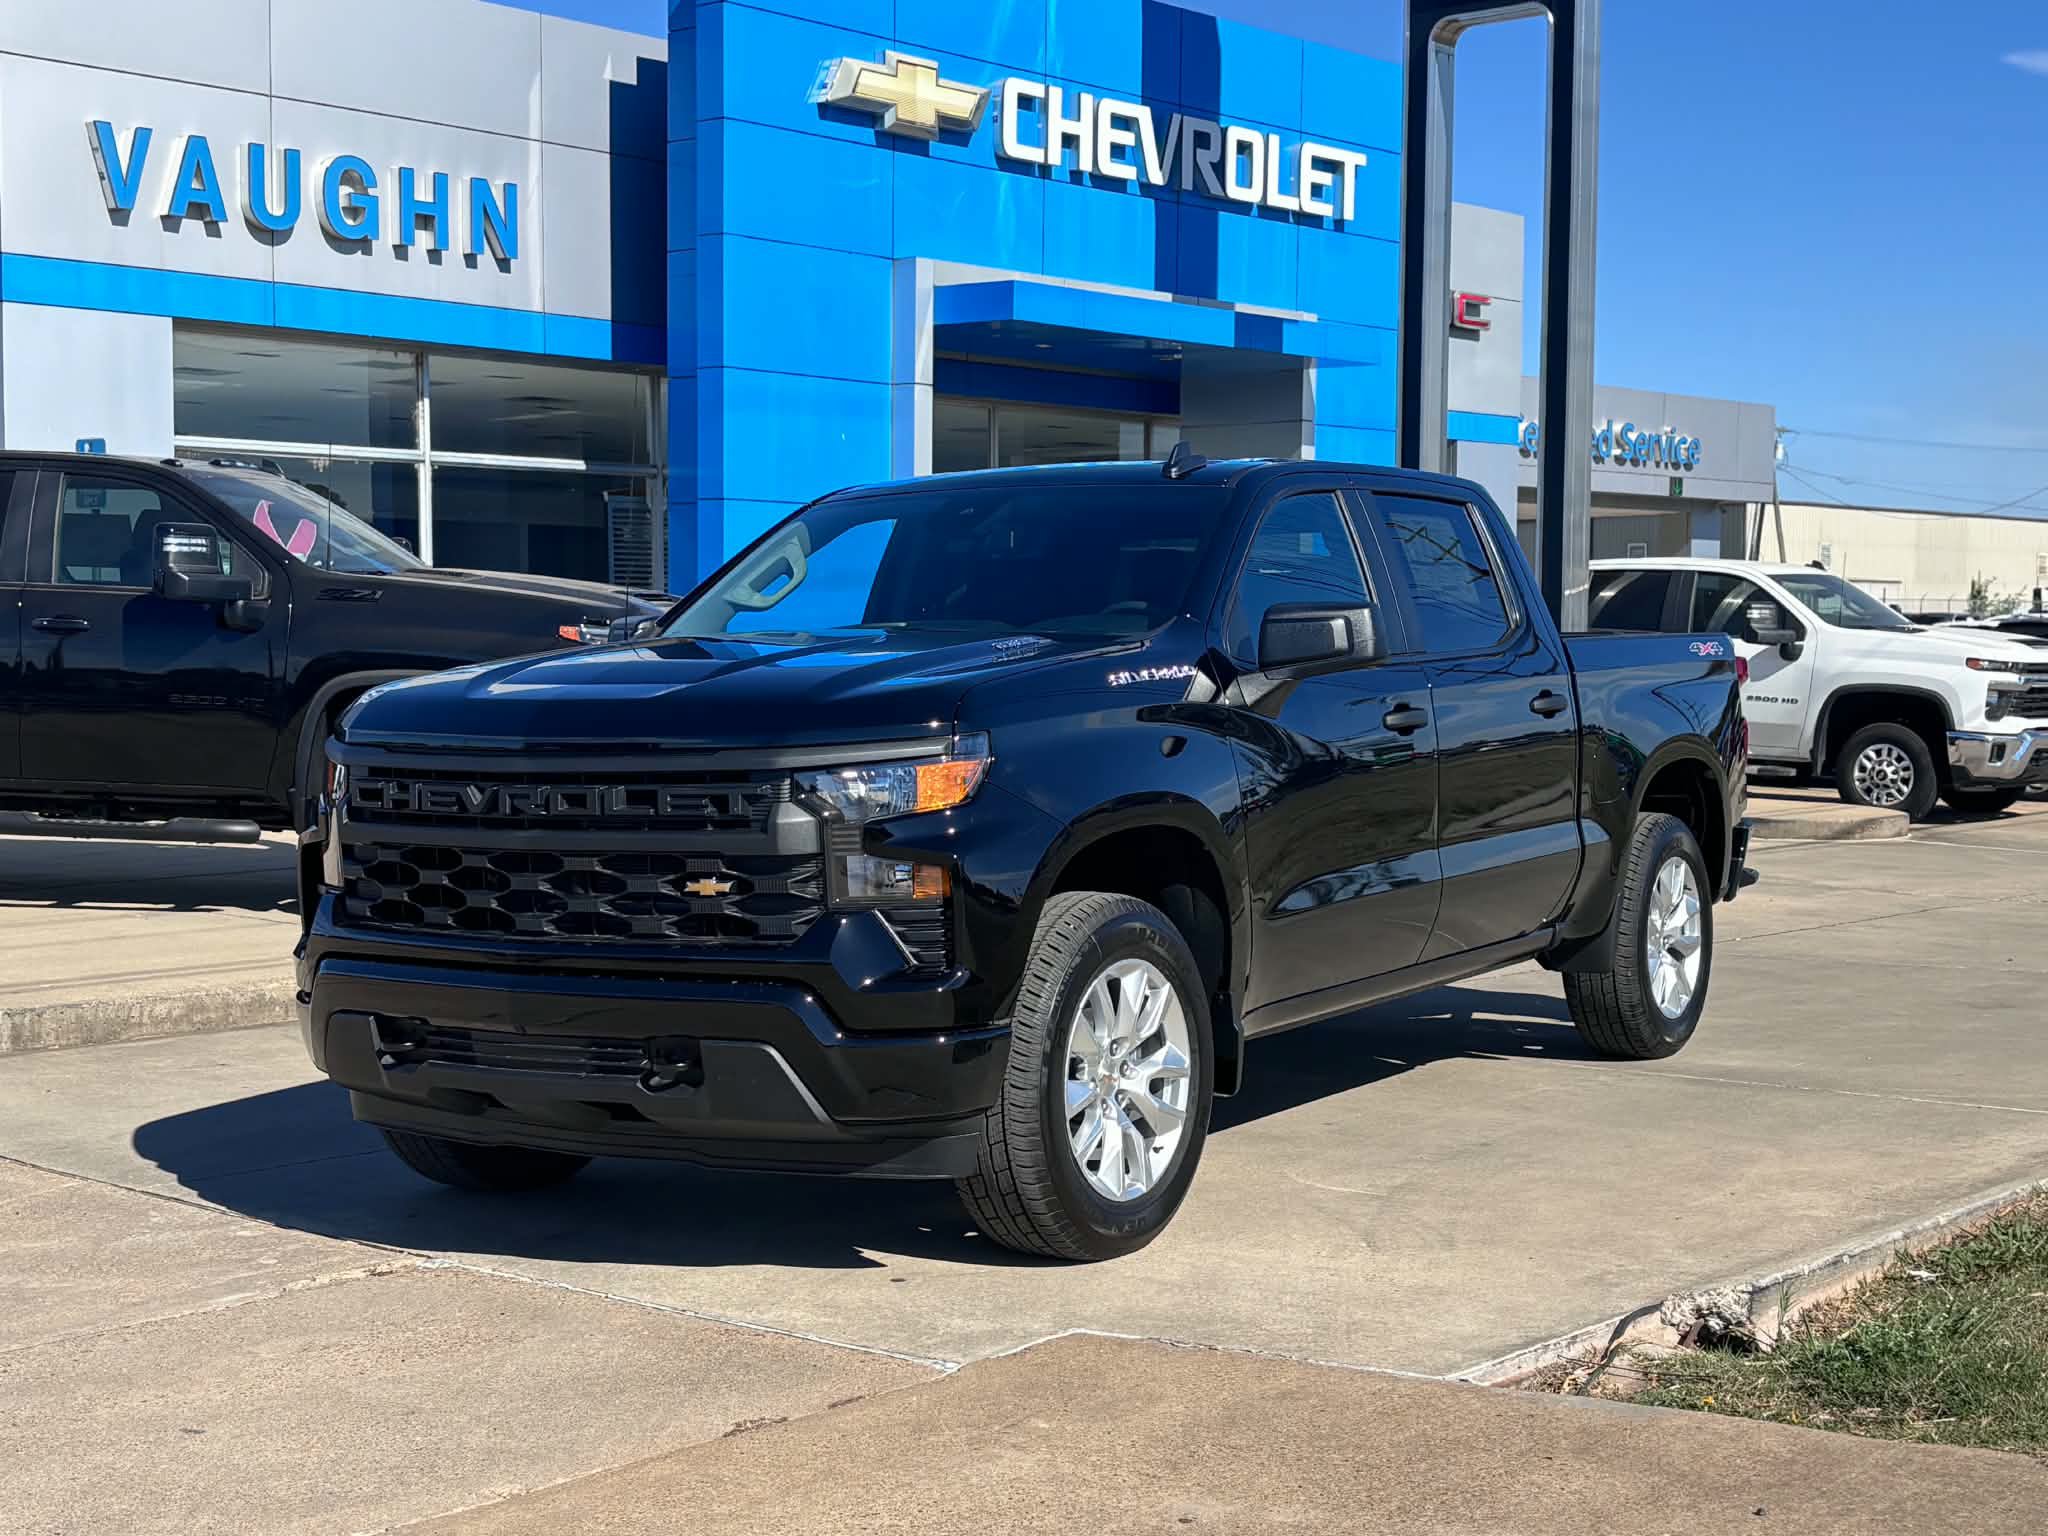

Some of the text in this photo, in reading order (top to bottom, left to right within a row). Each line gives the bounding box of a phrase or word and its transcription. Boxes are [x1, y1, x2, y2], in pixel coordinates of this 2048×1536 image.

[87, 119, 520, 261] VAUGHN
[1001, 76, 1368, 221] CHEVROLET
[1620, 422, 1701, 465] Service
[350, 777, 770, 817] CHEVROLET
